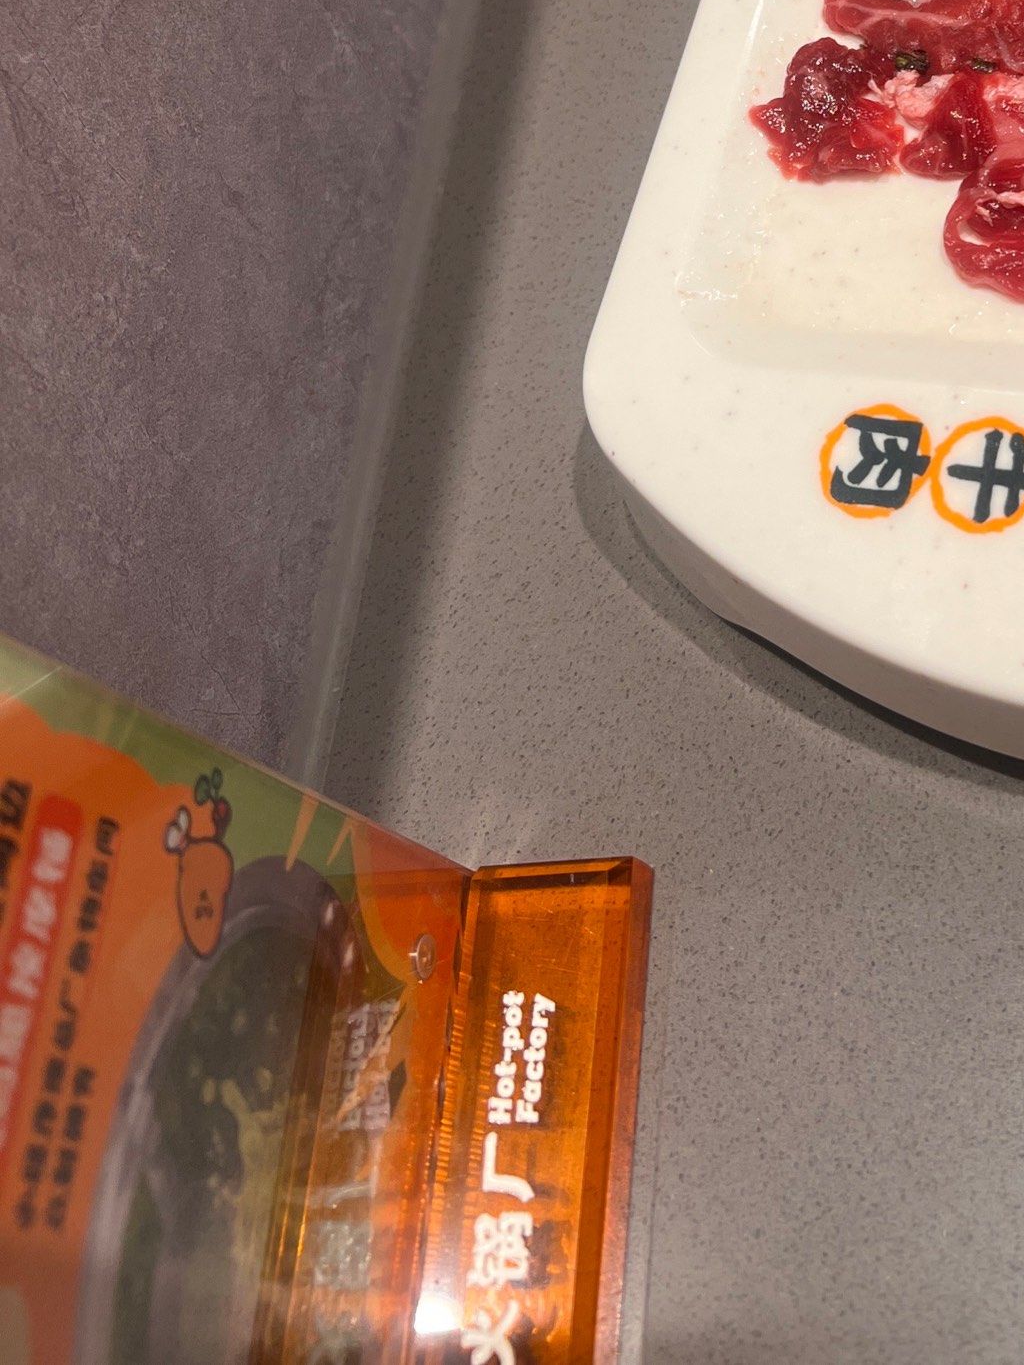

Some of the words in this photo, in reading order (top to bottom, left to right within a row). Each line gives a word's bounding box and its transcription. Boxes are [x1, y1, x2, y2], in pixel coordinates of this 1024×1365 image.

[487, 989, 525, 1125] Hot-pot
[514, 992, 556, 1124] Factory
[460, 1130, 536, 1365] 火锅厂
